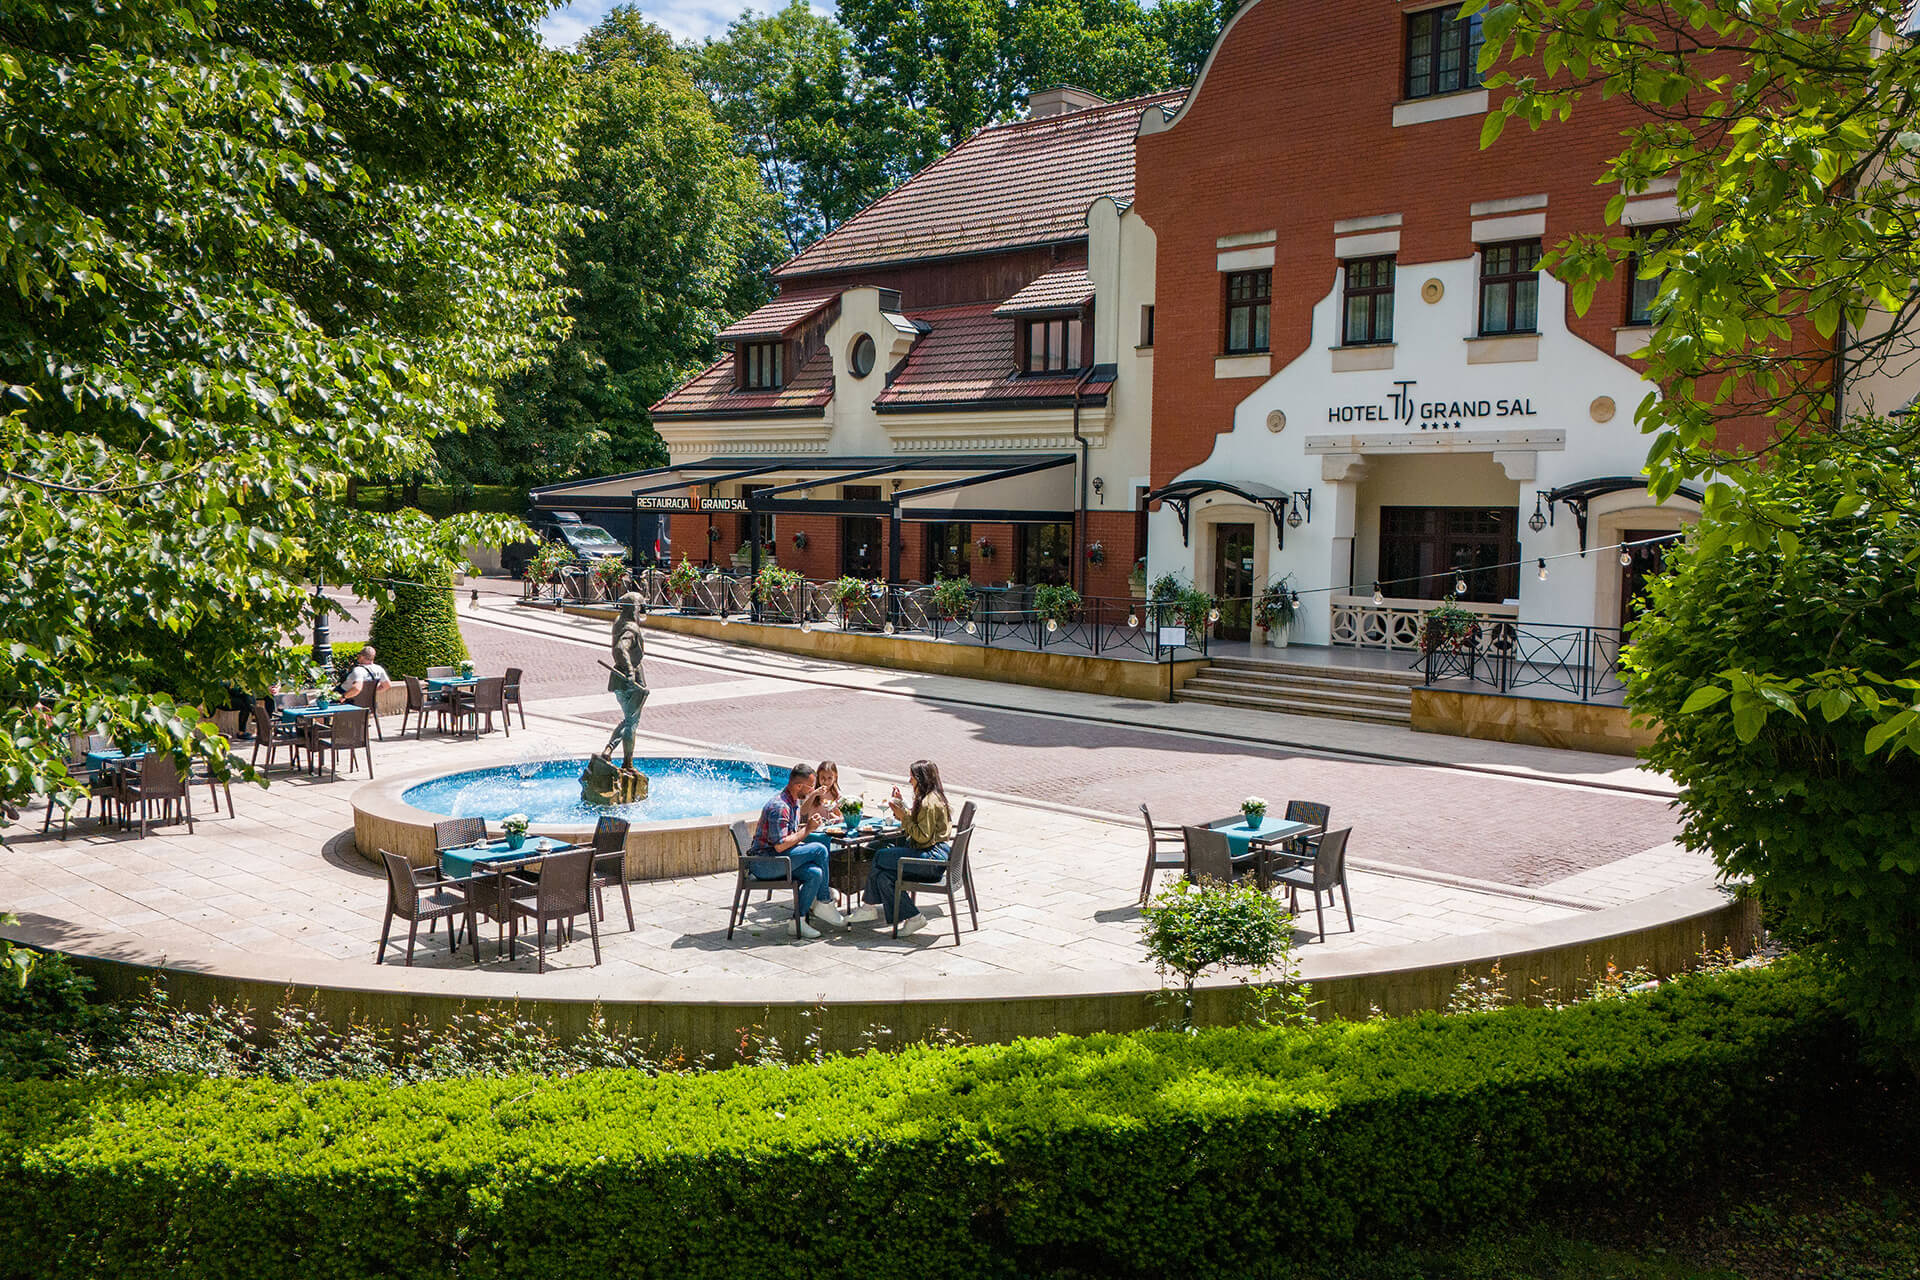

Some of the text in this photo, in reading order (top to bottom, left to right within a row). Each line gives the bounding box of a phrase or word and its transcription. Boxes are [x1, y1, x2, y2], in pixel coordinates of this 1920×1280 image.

[1328, 398, 1537, 422] HOTEL GRAND SAL
[637, 498, 748, 510] RESTAURACJA GRAND SAL
